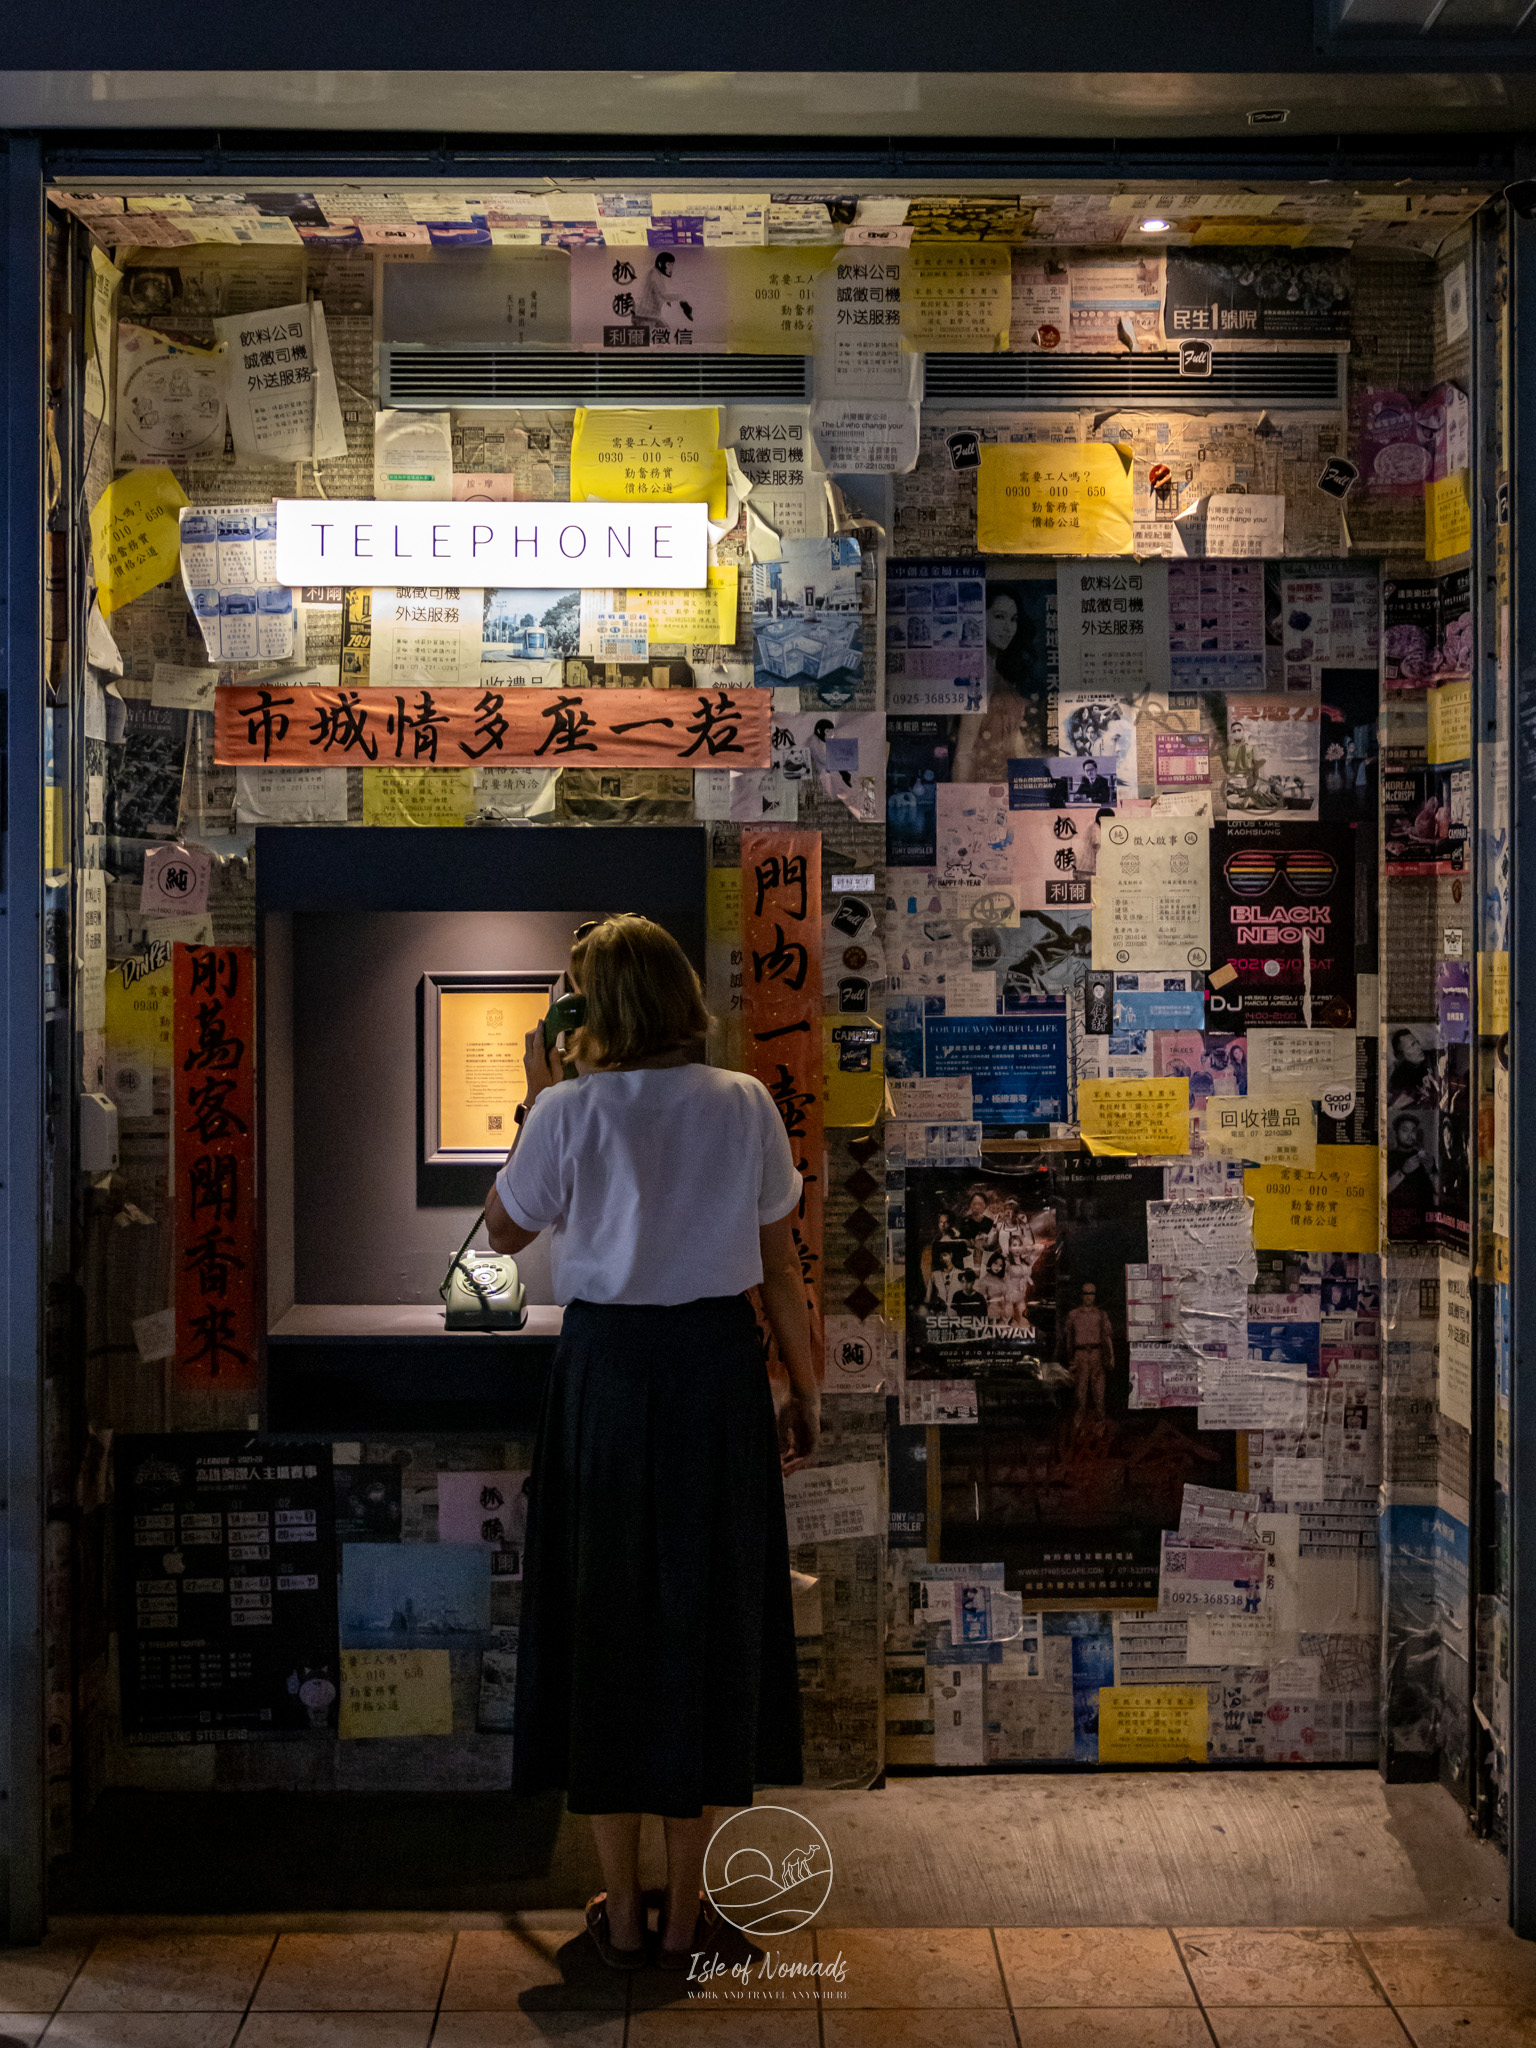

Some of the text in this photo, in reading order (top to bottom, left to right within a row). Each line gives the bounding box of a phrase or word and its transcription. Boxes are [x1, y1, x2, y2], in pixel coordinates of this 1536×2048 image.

[836, 264, 901, 280] 飲料公司
[836, 286, 901, 302] 誠徵司機
[836, 308, 901, 325] 外送服務
[239, 322, 304, 346] 飲料公司
[608, 328, 693, 346] 利爾徵信
[242, 345, 308, 370] 誠徵司機
[1184, 350, 1208, 365] Full
[247, 368, 312, 391] 外送服務
[739, 424, 804, 441] 飲料公司
[862, 422, 887, 430] change
[888, 423, 904, 431] your
[598, 452, 700, 462] 0930 010 650
[739, 448, 804, 464] 誠徵司機
[952, 444, 976, 459] Full
[624, 466, 674, 478] 勤奮務實
[1324, 466, 1350, 487] Full
[624, 482, 674, 494] 價格公道
[1005, 486, 1106, 497] 0930 010 650
[145, 505, 164, 522] 650
[1031, 501, 1080, 513] 勤奮務實
[1031, 516, 1080, 528] 價格公道
[1226, 516, 1252, 524] change
[311, 524, 673, 558] TELEPHONE
[1080, 576, 1144, 592] 飲料公司
[1080, 598, 1144, 614] 誠徵司機
[395, 607, 460, 624] 外送服務
[1080, 620, 1144, 636] 外送服務
[347, 634, 370, 647] 799
[892, 693, 965, 704] 0925-368538
[1386, 780, 1416, 790] KOREAN
[1386, 790, 1416, 801] McCRISPY
[1050, 882, 1088, 901] 利爾
[838, 907, 863, 927] Full
[1230, 905, 1332, 924] BLACK
[1236, 926, 1326, 944] NEON
[842, 990, 866, 1003] Full
[1210, 996, 1243, 1012] DJ
[972, 1024, 1034, 1034] WONDERFUL
[1036, 1024, 1058, 1032] LIFE
[1324, 1092, 1352, 1103] Good
[1220, 1108, 1301, 1128] 回收禮品
[1096, 1173, 1133, 1182] experience
[1266, 1184, 1364, 1198] 0930 010 650
[926, 1316, 1017, 1328] SERENITY
[970, 1326, 1036, 1340] TAIWAN
[1172, 1592, 1243, 1606] 0925-368538
